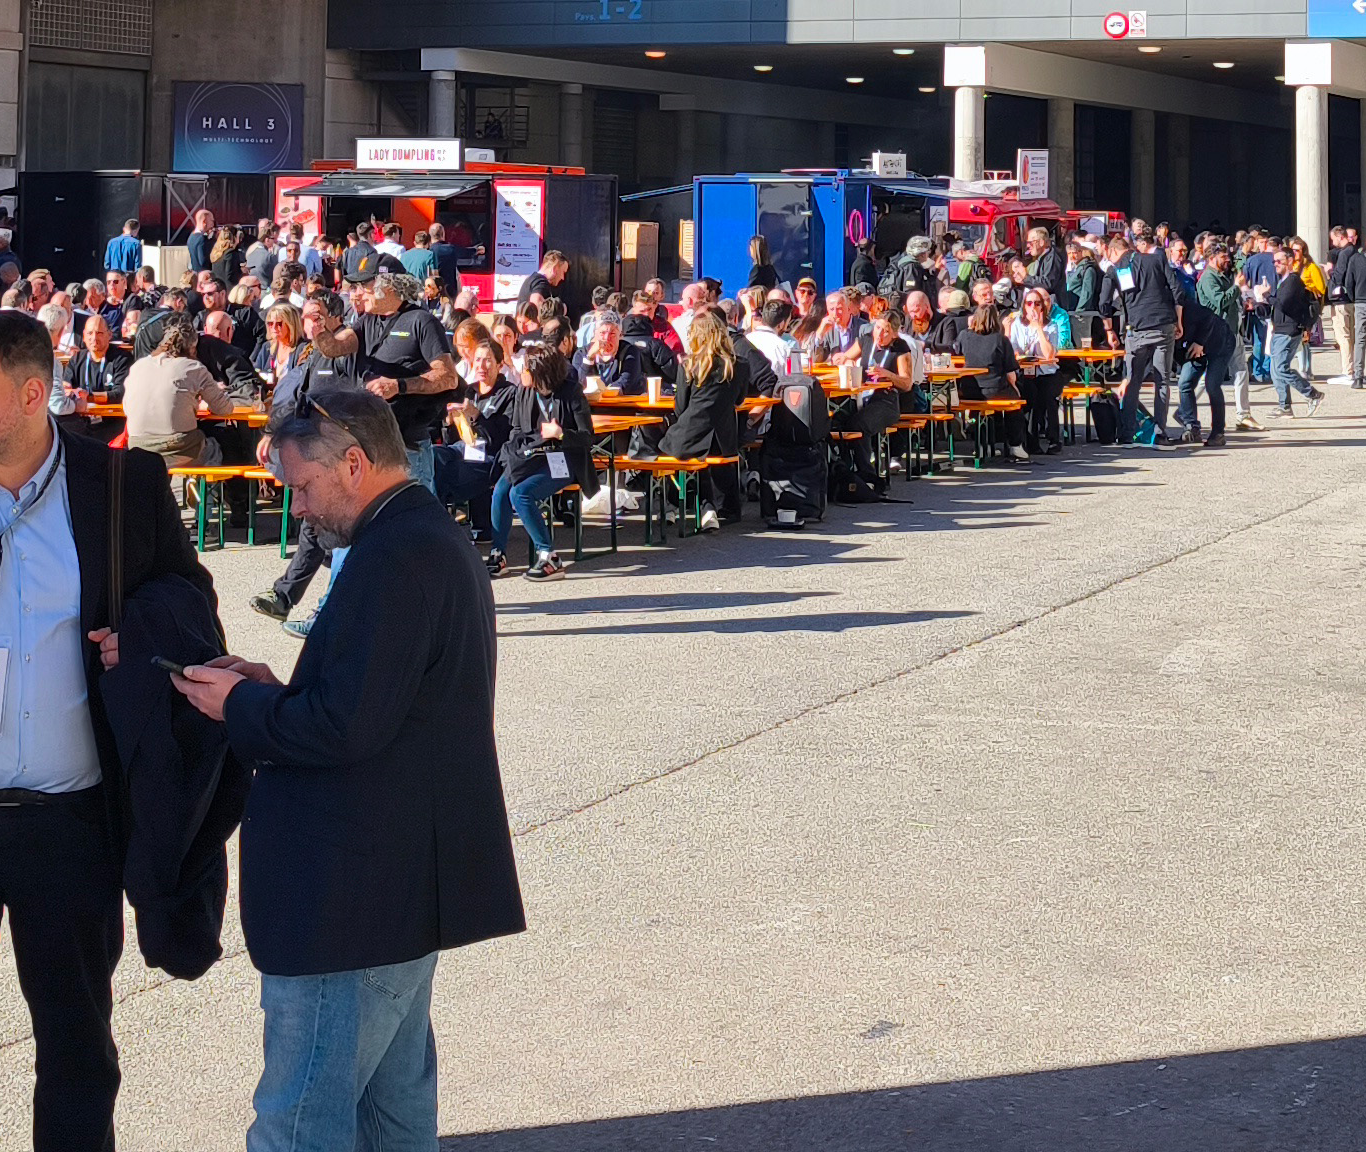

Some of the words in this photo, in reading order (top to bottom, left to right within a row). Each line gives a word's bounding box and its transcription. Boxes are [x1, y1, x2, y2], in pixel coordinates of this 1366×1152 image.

[202, 116, 253, 130] HALL
[266, 117, 276, 131] 3
[368, 148, 390, 161] LADY
[392, 148, 435, 161] DUMPLING
